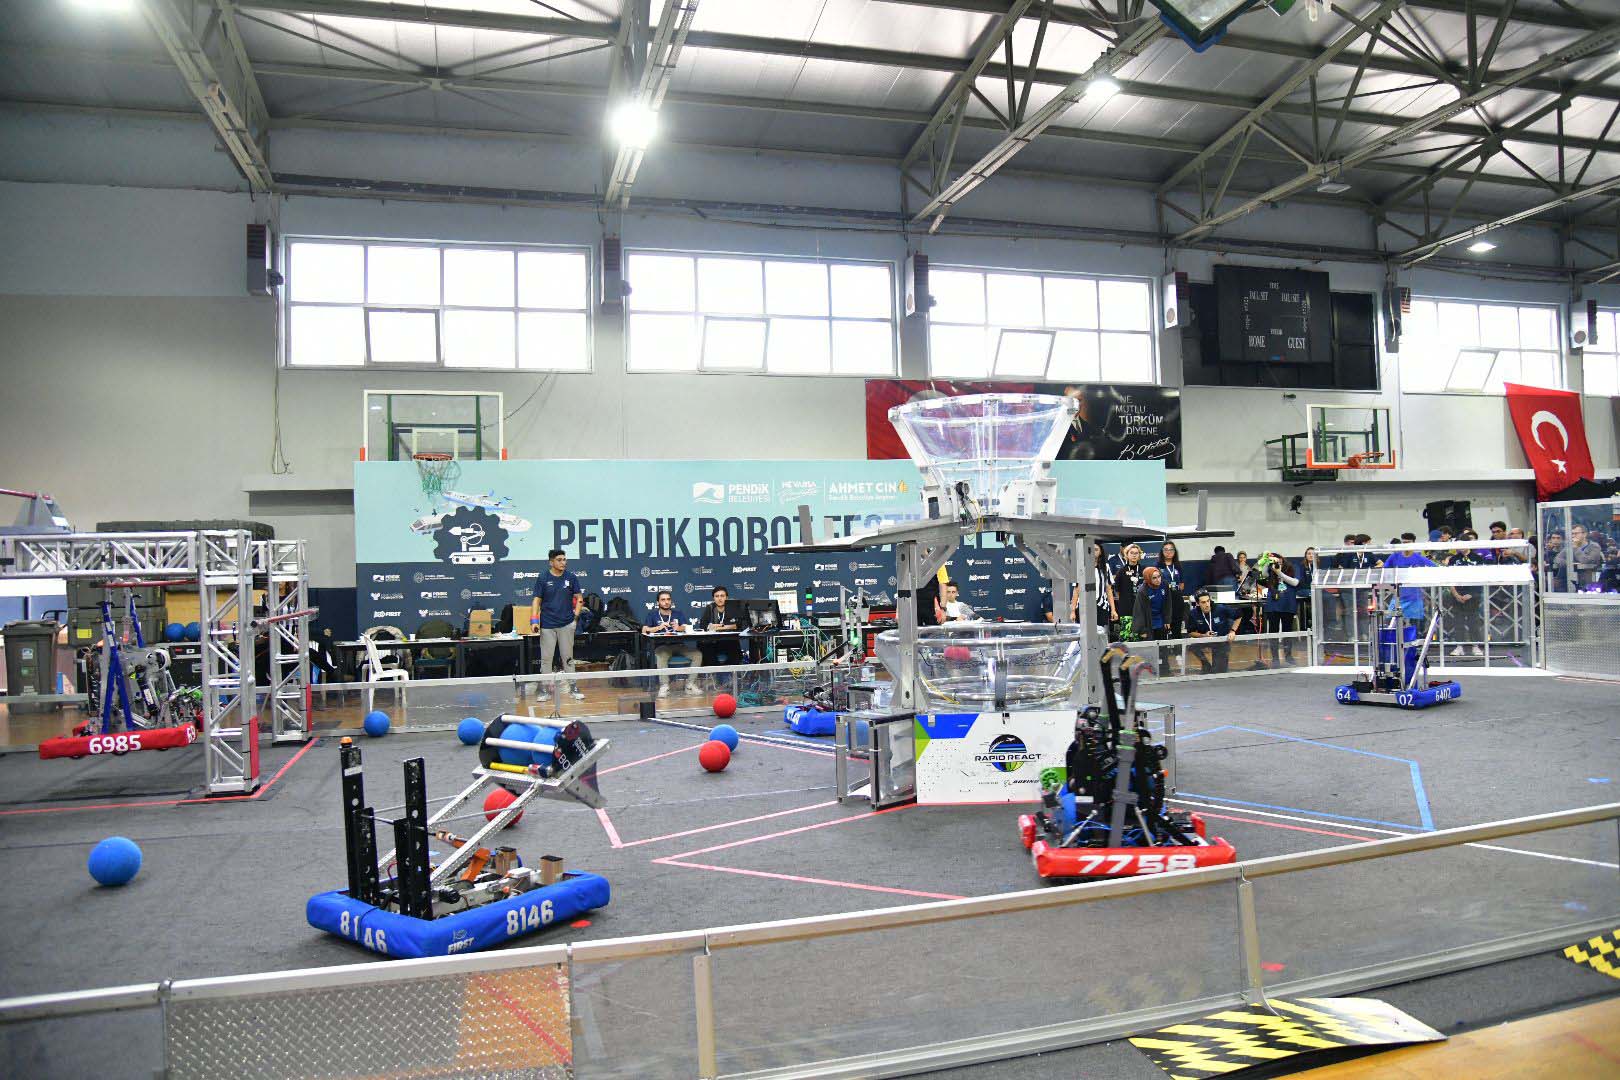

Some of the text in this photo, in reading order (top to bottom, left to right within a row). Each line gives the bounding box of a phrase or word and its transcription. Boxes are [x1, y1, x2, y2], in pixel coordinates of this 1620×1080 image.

[1287, 337, 1305, 349] GUEST
[1115, 405, 1146, 414] MUTLU
[1119, 414, 1163, 425] TÜRKÜM
[1126, 426, 1158, 435] DİYENE
[830, 482, 874, 494] AHMET
[1336, 688, 1414, 706] 64 02
[1435, 687, 1452, 702] 6402
[89, 734, 142, 754] 6985
[975, 753, 1042, 762] RAPID REACT
[1077, 854, 1197, 874] 7758
[507, 899, 554, 936] 8146
[447, 936, 475, 955] FIRST
